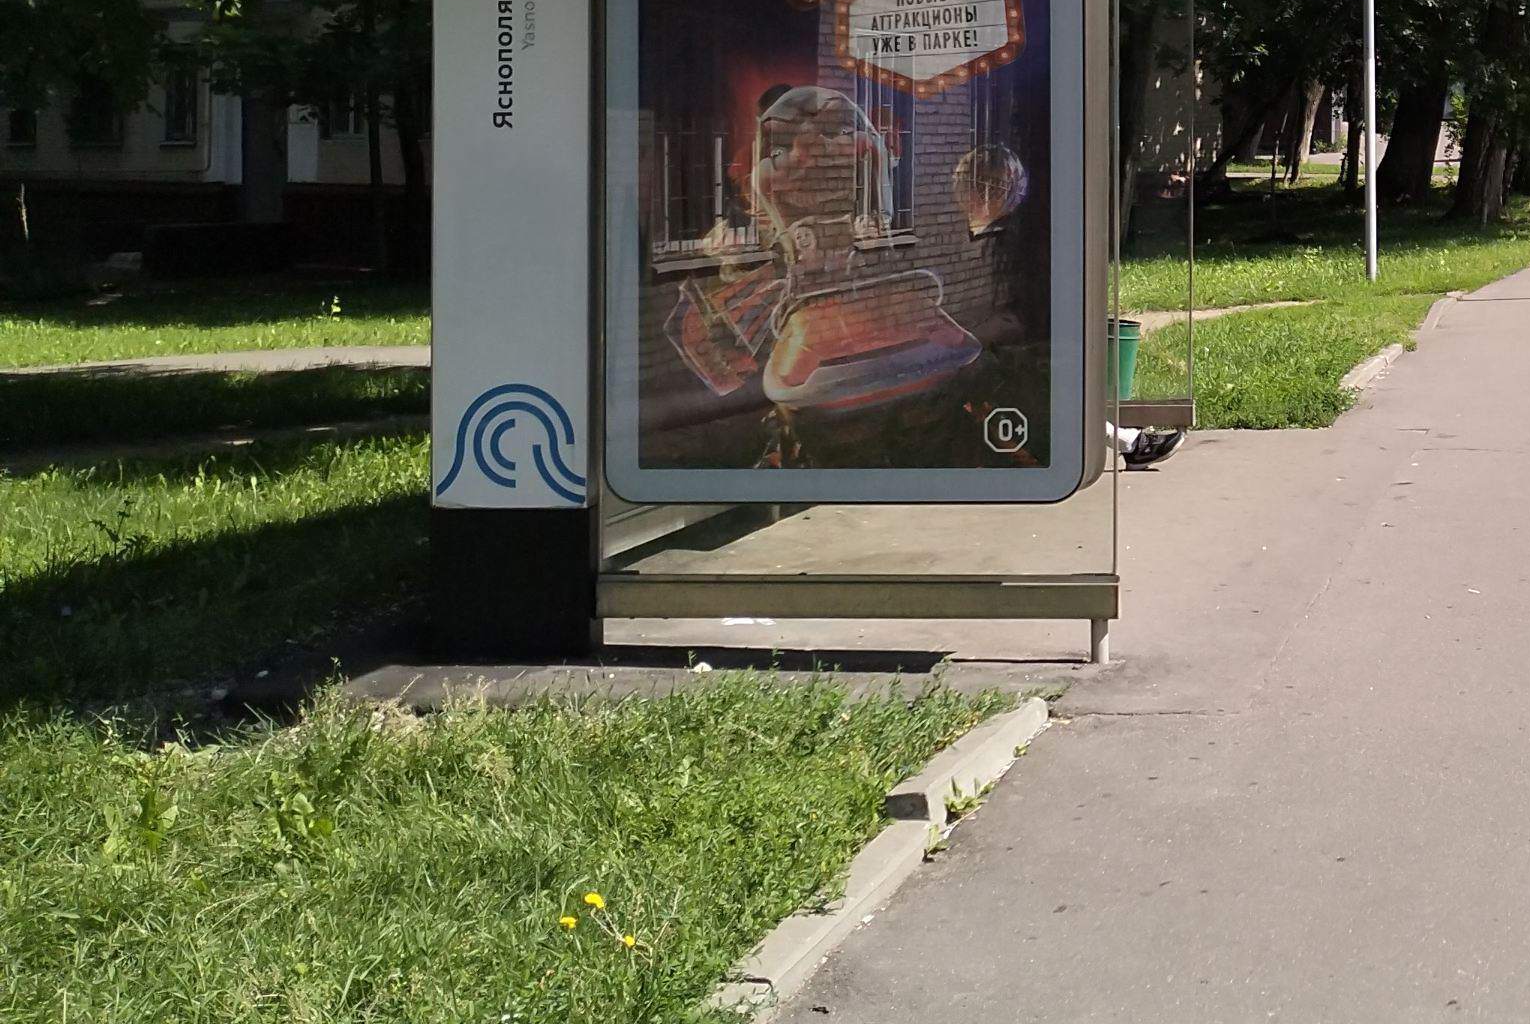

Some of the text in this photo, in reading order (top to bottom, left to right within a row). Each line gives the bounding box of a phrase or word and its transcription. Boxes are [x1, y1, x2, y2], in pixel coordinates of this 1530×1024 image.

[870, 5, 978, 31] АТТРАКЦИОНЫ
[872, 29, 979, 56] УЖЕ В ПАРКЕ!
[998, 419, 1025, 441] 0+
